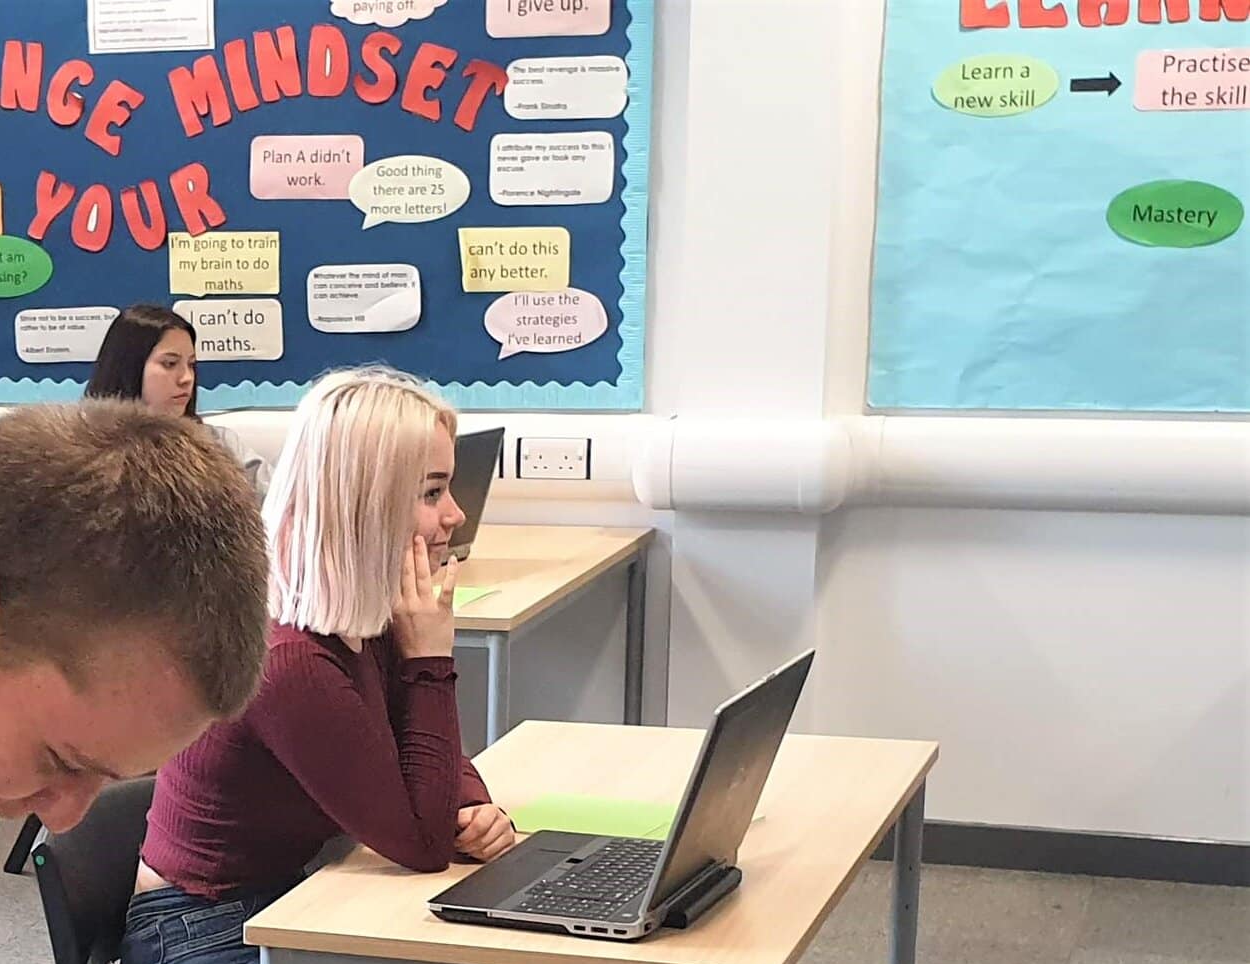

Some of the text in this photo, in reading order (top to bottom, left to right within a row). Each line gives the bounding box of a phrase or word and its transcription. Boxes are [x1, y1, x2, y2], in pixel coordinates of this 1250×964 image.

[352, 0, 417, 13] paying off.
[507, 0, 589, 16] I give up.
[1163, 53, 1250, 75] Practise
[961, 64, 1031, 81] Learn a
[168, 24, 508, 137] MINDSET
[954, 90, 1035, 109] new skill
[1161, 85, 1247, 107] the skill
[262, 149, 351, 164] Plan A didn't
[286, 173, 325, 186] work.
[376, 165, 442, 179] Good thing
[373, 183, 445, 196] there are 25
[27, 162, 227, 251] YOUR
[370, 201, 447, 215] more letters!
[1132, 203, 1218, 227] Mastery
[171, 236, 277, 252] I'm going to train
[468, 241, 559, 256] can't do this
[5, 253, 25, 263] am
[179, 257, 270, 272] my brain to do
[470, 264, 548, 281] any better.
[205, 279, 244, 290] maths
[514, 294, 580, 306] I'll use the
[191, 309, 265, 326] I can't do
[516, 315, 578, 328] strategies
[201, 336, 256, 352] maths.
[508, 332, 585, 345] I've learned.
